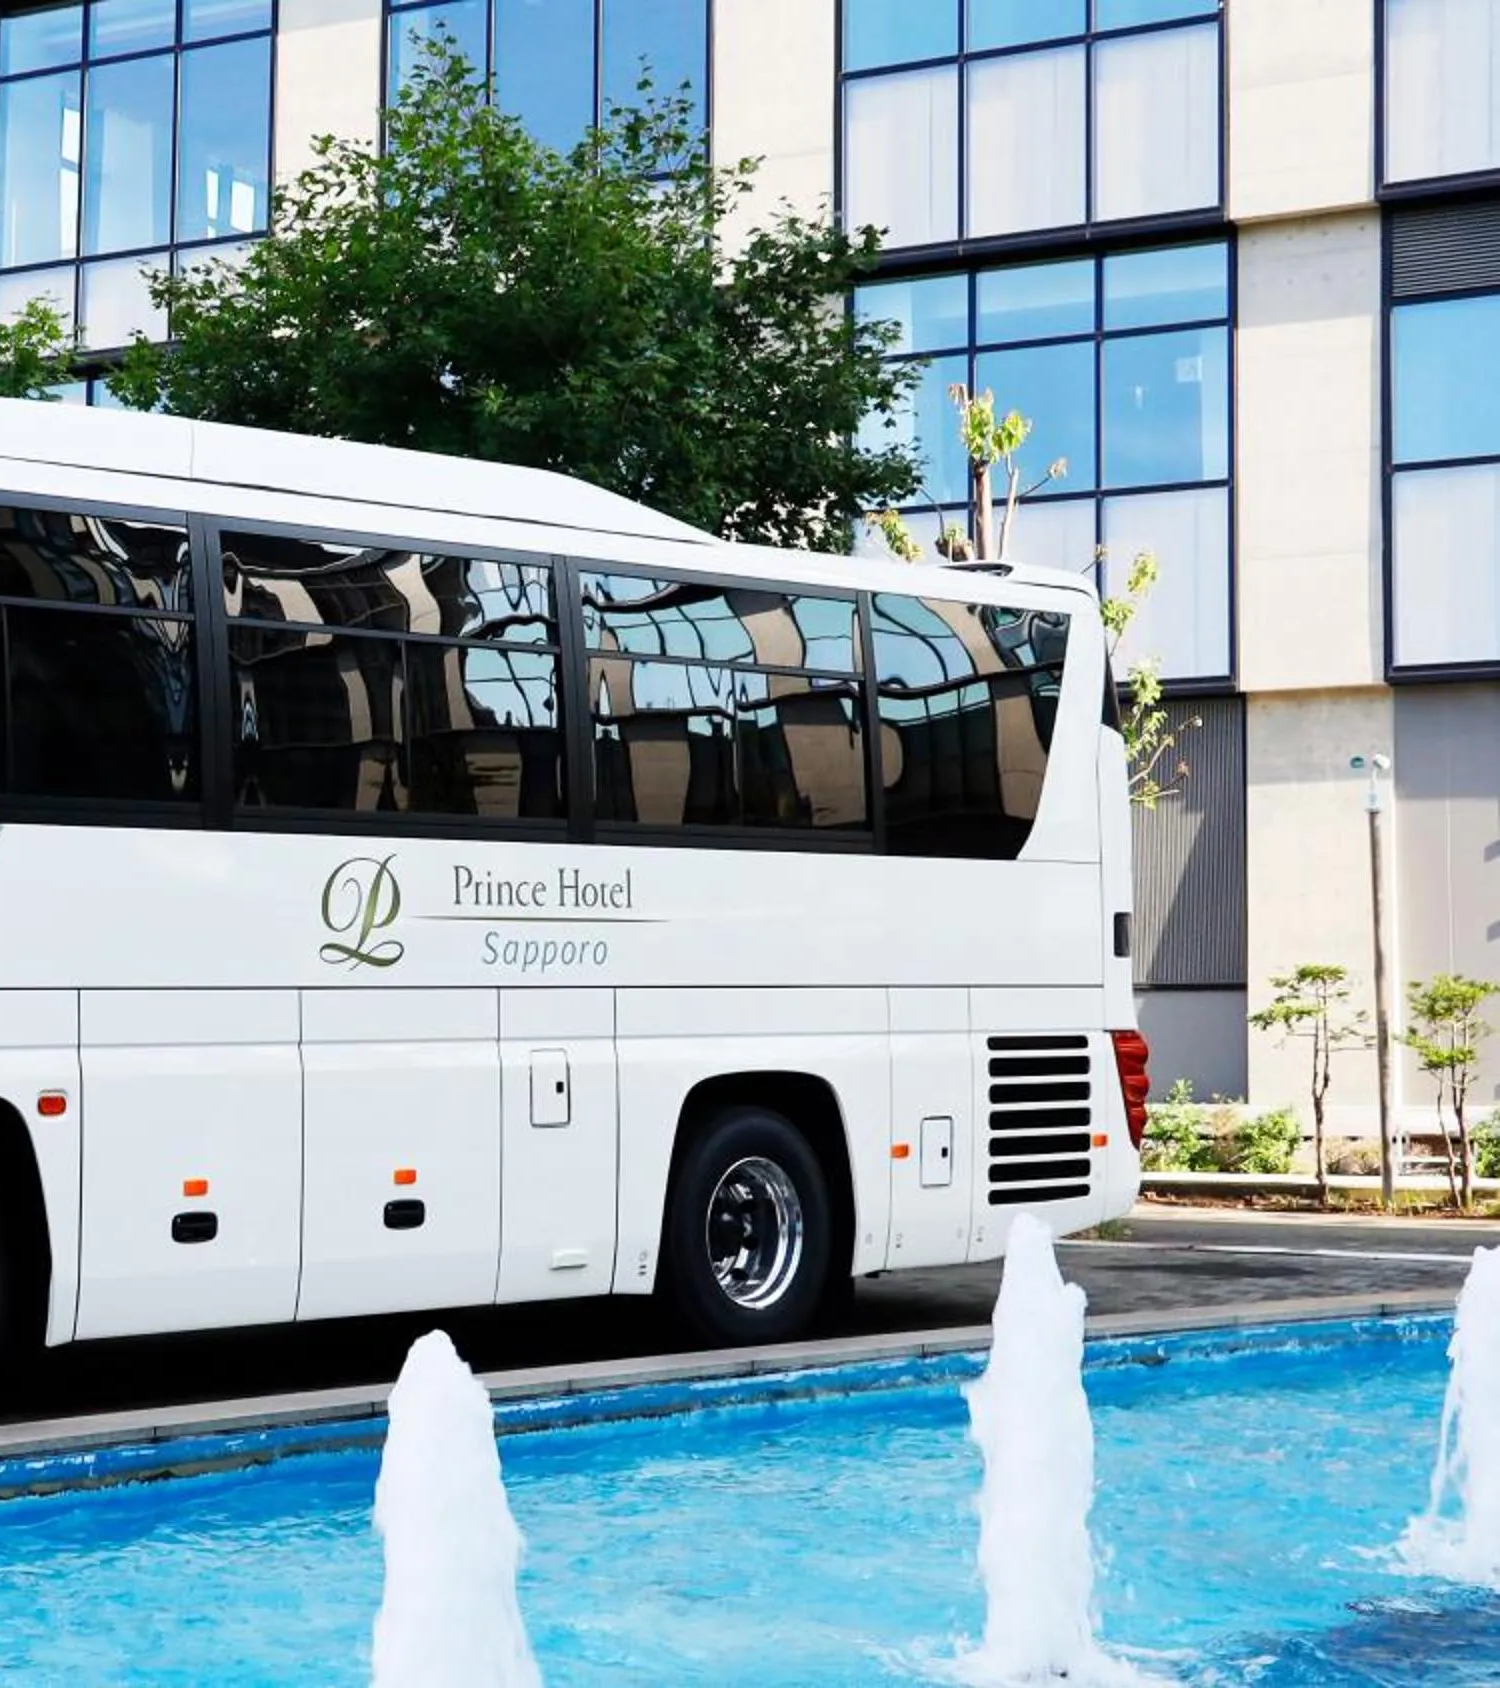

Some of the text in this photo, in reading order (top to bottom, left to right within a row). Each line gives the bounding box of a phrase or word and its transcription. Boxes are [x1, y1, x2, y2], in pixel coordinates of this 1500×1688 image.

[453, 865, 633, 909] Prince Hotel
[482, 931, 609, 973] Sapporo
